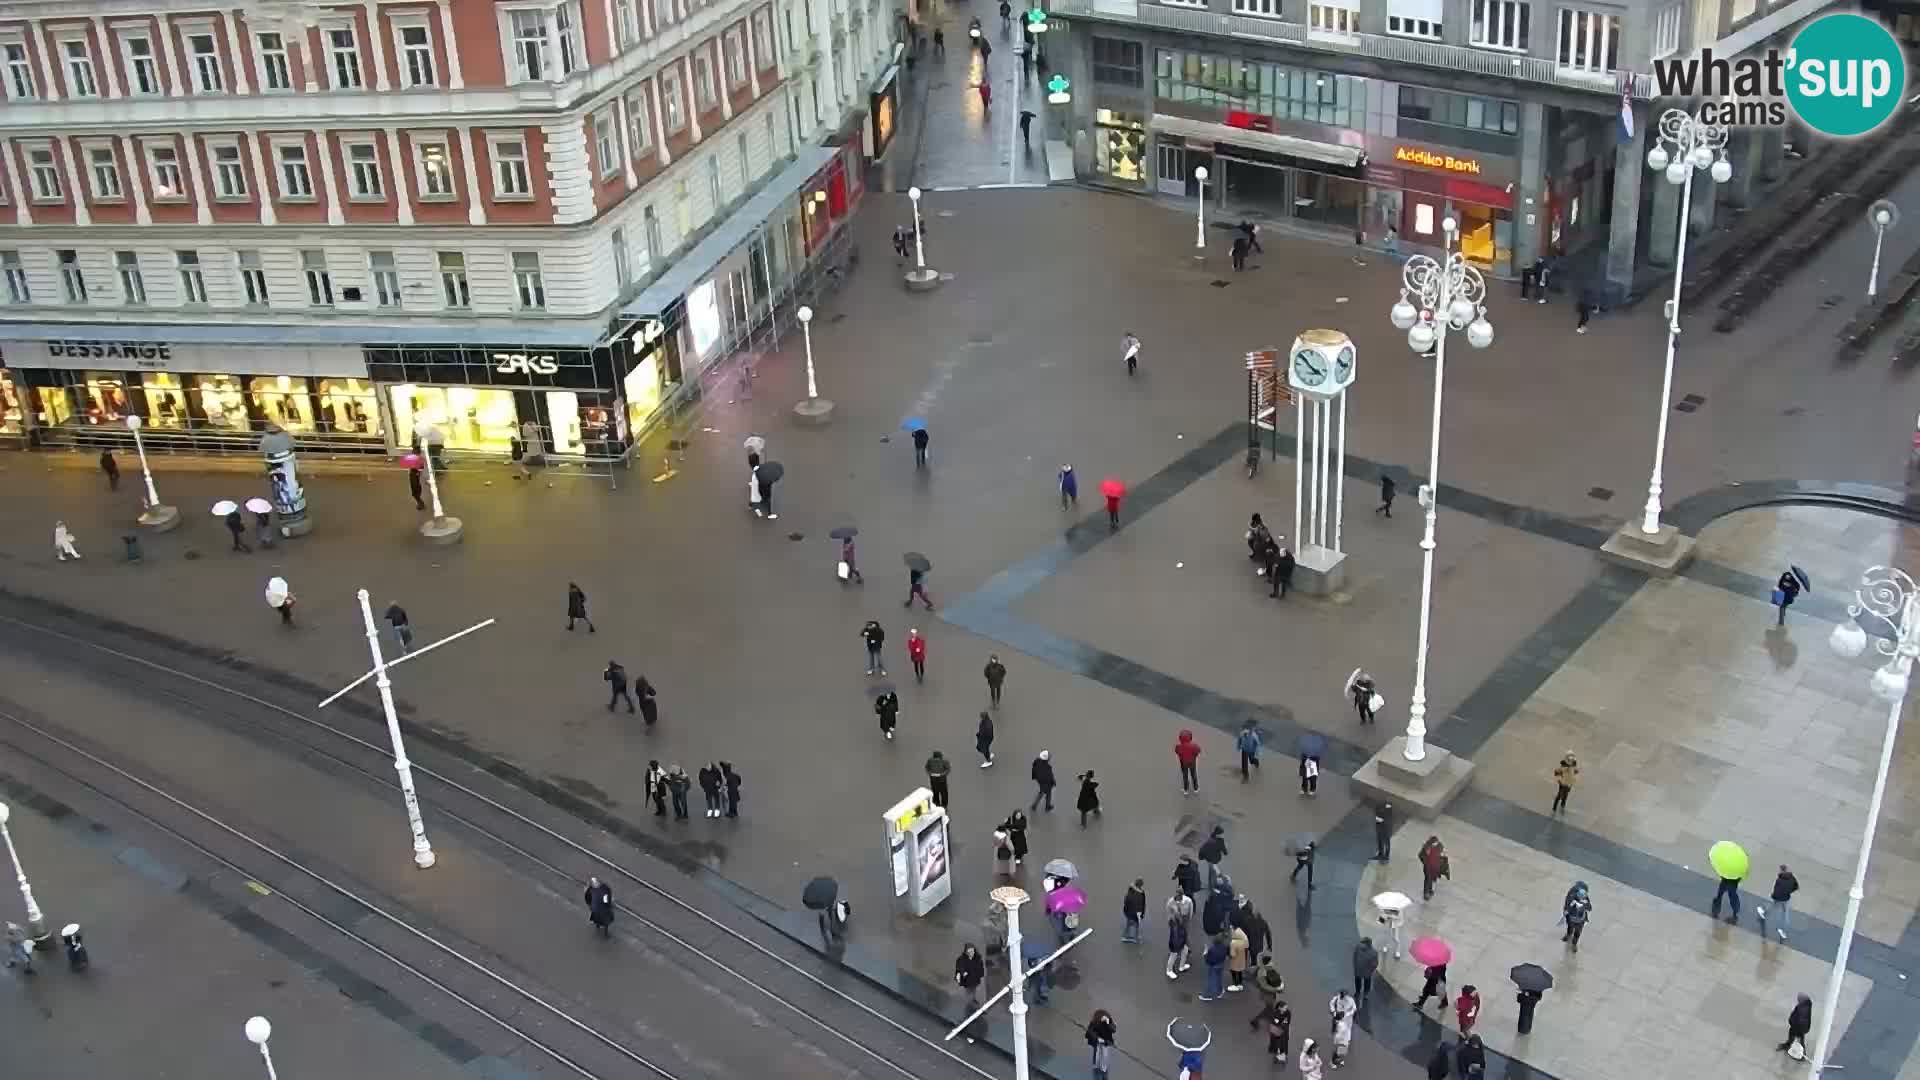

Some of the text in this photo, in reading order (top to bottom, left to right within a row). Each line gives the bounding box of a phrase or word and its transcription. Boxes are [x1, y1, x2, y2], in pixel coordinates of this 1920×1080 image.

[1396, 147, 1480, 174] Addiko Bank
[48, 340, 171, 360] DESSANGE
[493, 354, 558, 375] ZAKS
